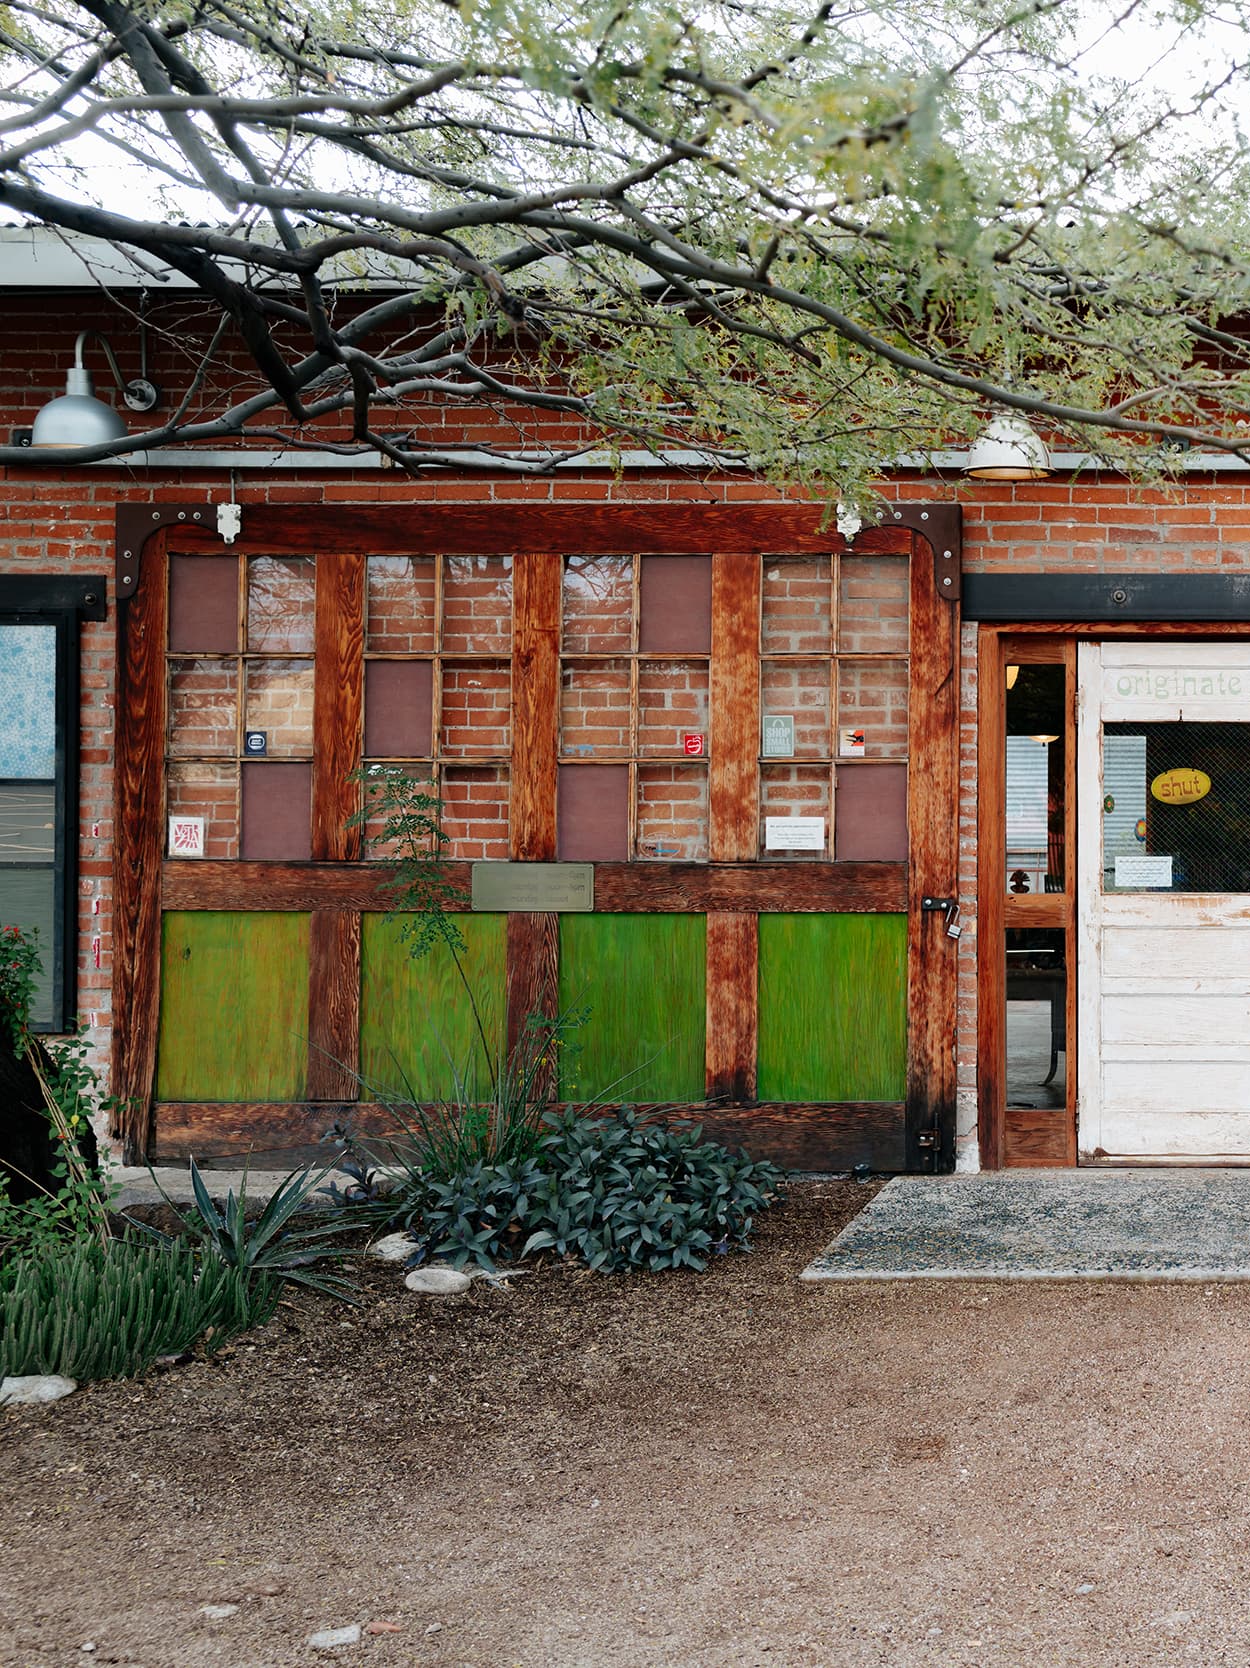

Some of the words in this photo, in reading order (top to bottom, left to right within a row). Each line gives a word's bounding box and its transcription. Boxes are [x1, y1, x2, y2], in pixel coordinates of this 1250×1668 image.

[1117, 671, 1242, 699] originate
[766, 727, 791, 737] SHOP
[1161, 776, 1201, 797] shut
